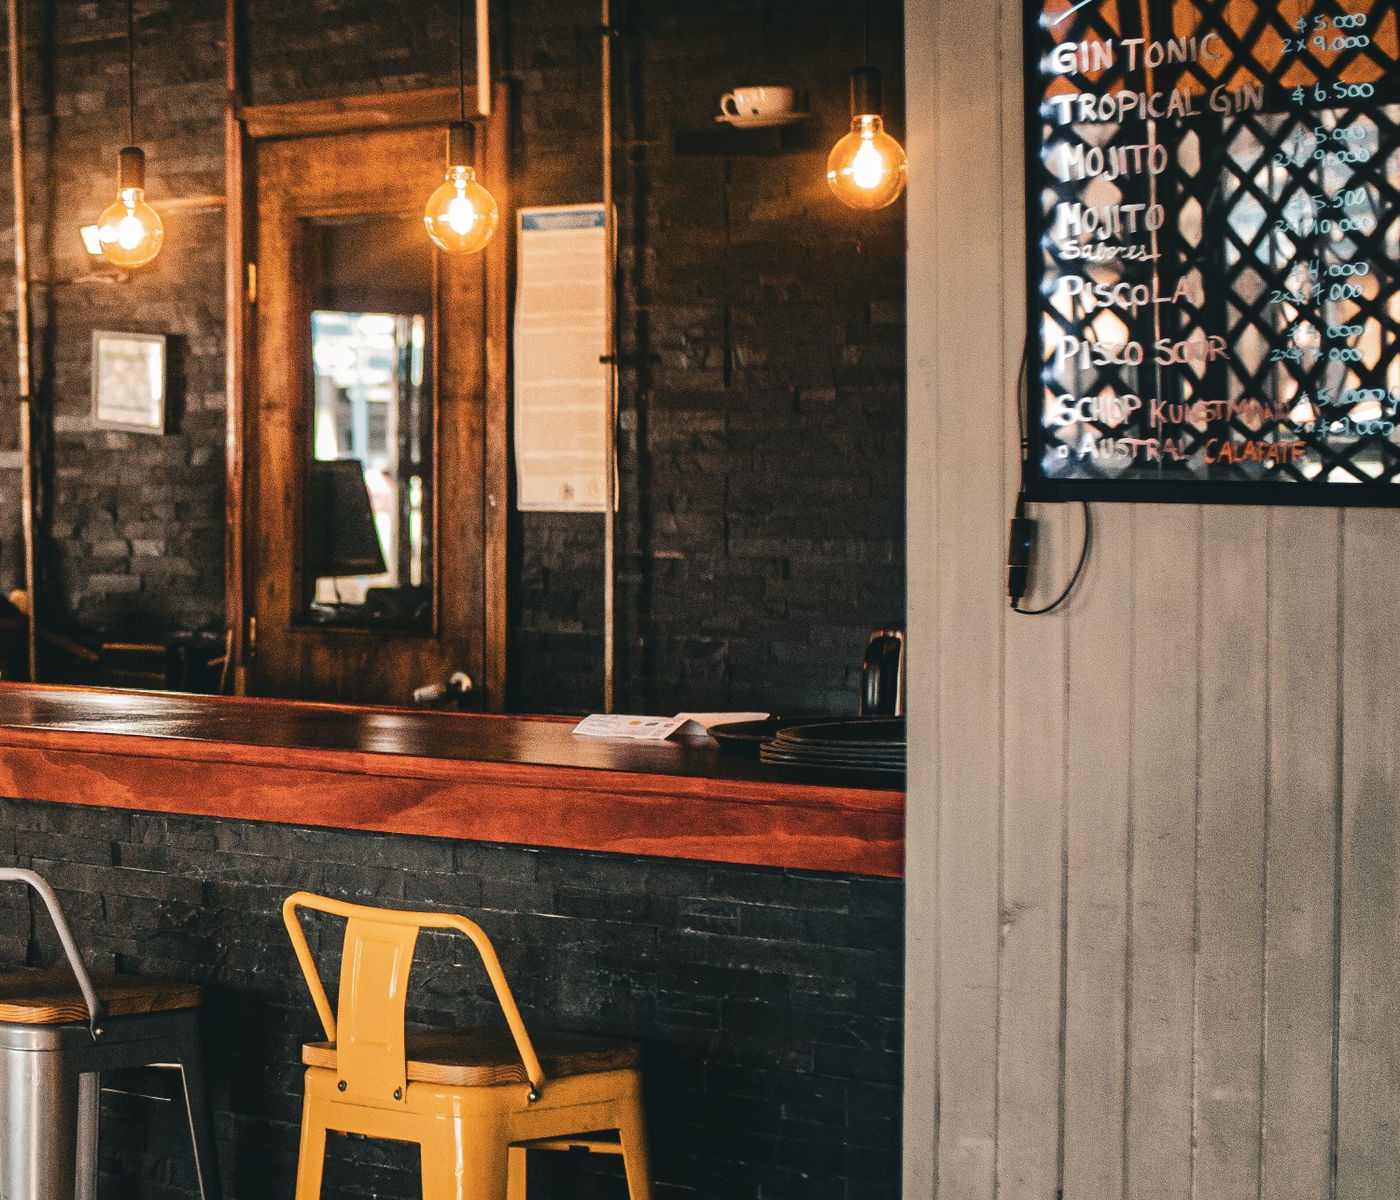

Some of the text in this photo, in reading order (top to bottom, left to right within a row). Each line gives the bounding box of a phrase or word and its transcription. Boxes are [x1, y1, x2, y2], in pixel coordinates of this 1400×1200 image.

[1051, 32, 1224, 76] GIN TONIC
[1313, 35, 1370, 51] 9.000
[1051, 82, 1265, 125] TROPICAL GIN
[1314, 80, 1375, 102] 6.500
[1057, 143, 1168, 183] MOJITO
[1057, 202, 1165, 240] MOJITO
[1059, 240, 1162, 262] Sabores
[1056, 275, 1194, 313] PISCOLA
[1056, 335, 1144, 371] PISCO
[1054, 393, 1142, 426] SCHOP
[1079, 431, 1192, 463] AUSTRAL
[1203, 438, 1307, 464] CALAFATE
